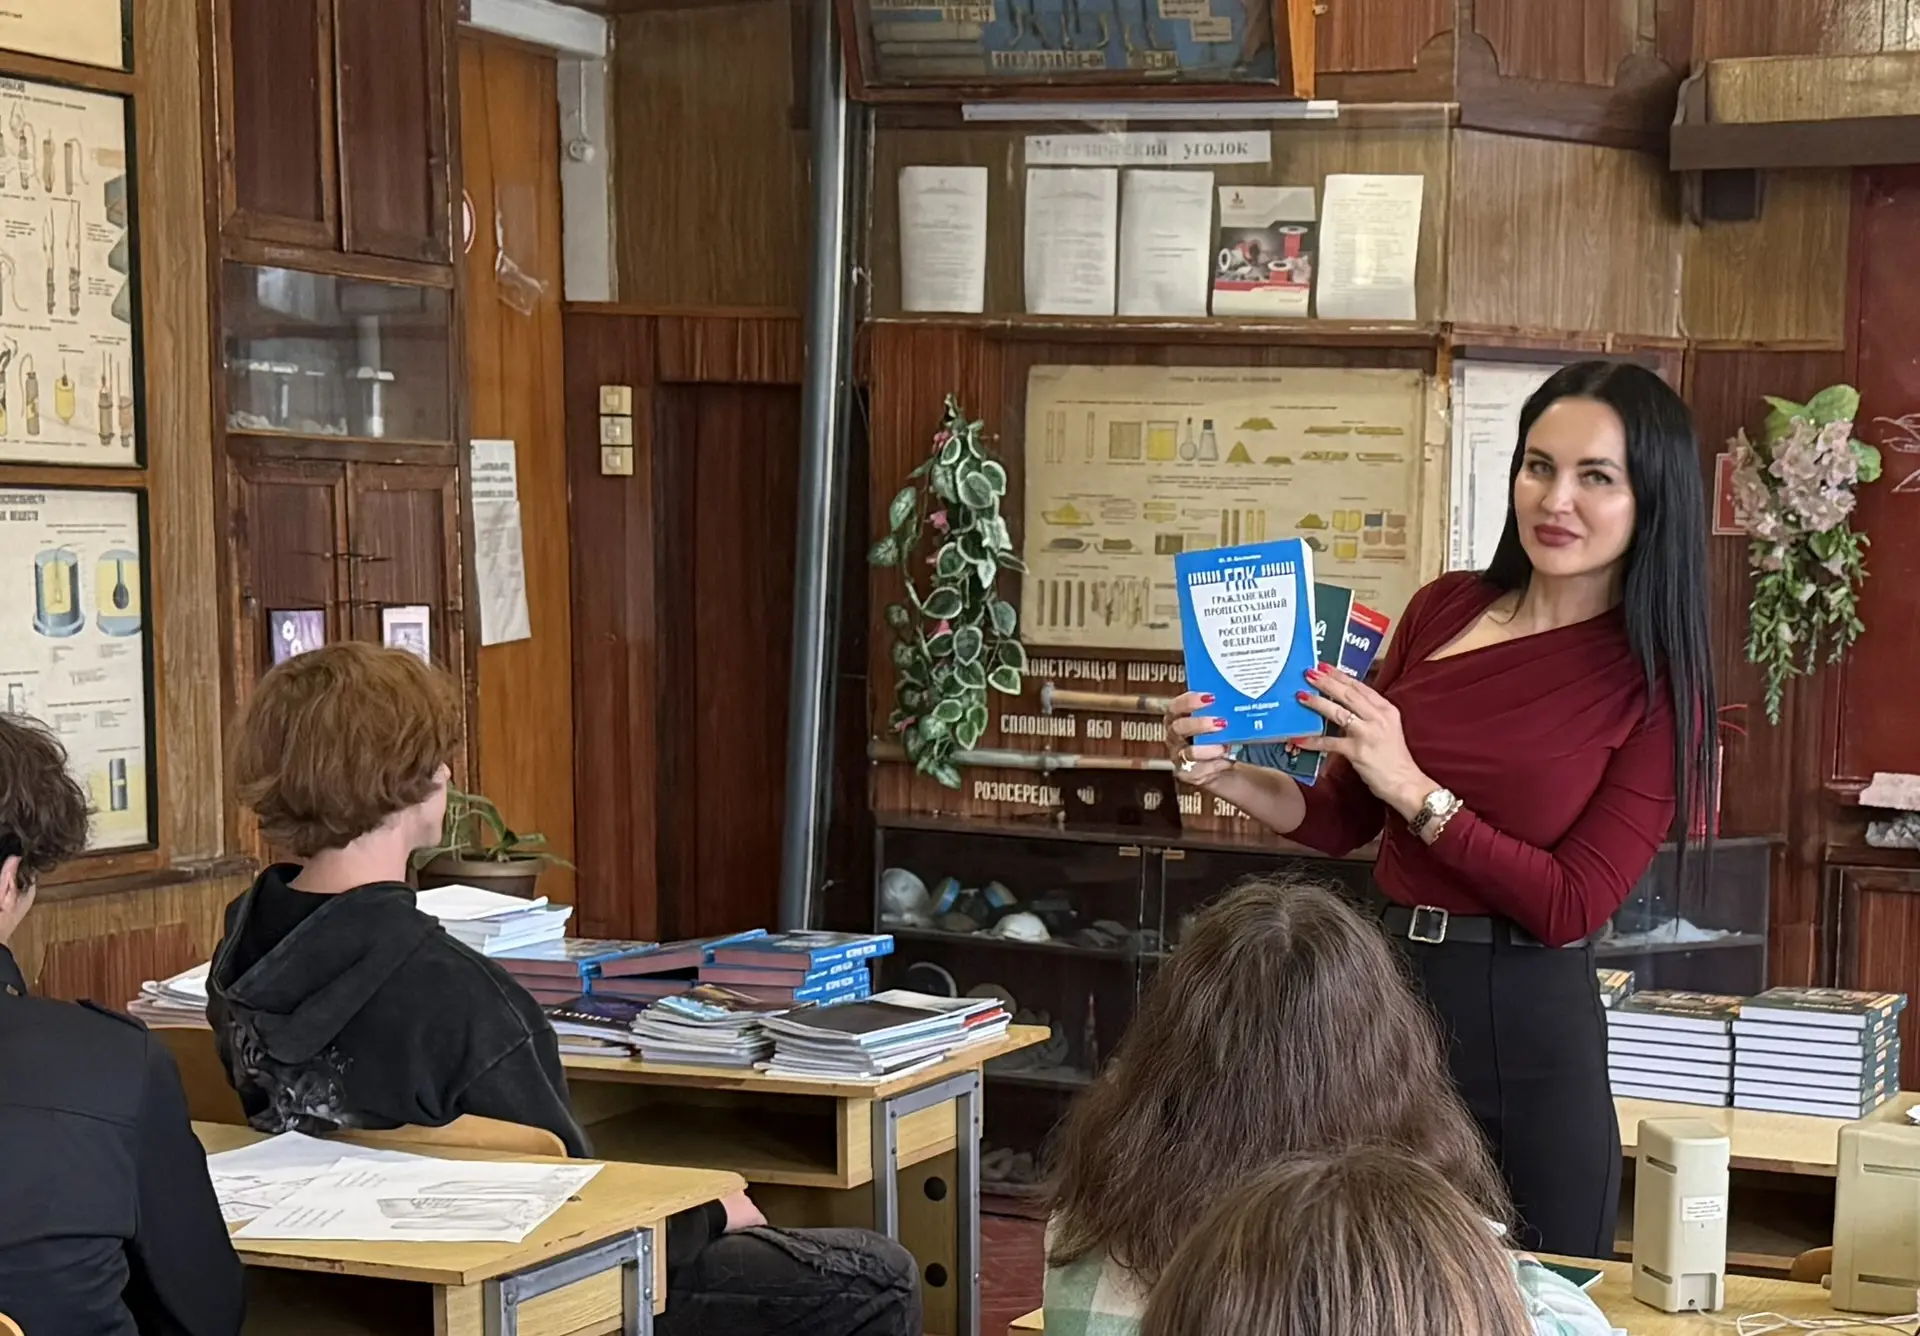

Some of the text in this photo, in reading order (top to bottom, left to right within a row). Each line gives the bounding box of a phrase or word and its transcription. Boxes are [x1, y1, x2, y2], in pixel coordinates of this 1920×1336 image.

[1184, 142, 1248, 160] уголок
[1224, 565, 1259, 592] ГПК
[1211, 587, 1277, 605] ГРАЖДАНСКИЙ
[1204, 598, 1288, 617] ПРОЦЕССУАЛЬНЫЙ
[1230, 613, 1264, 625] КОДЕКС
[1218, 621, 1278, 637] РОССИЙСКОЙ
[1222, 633, 1276, 648] ФЕДЕРАЦИИ
[1001, 714, 1166, 742] СПЛОШНИЙ АБО КОЛОН
